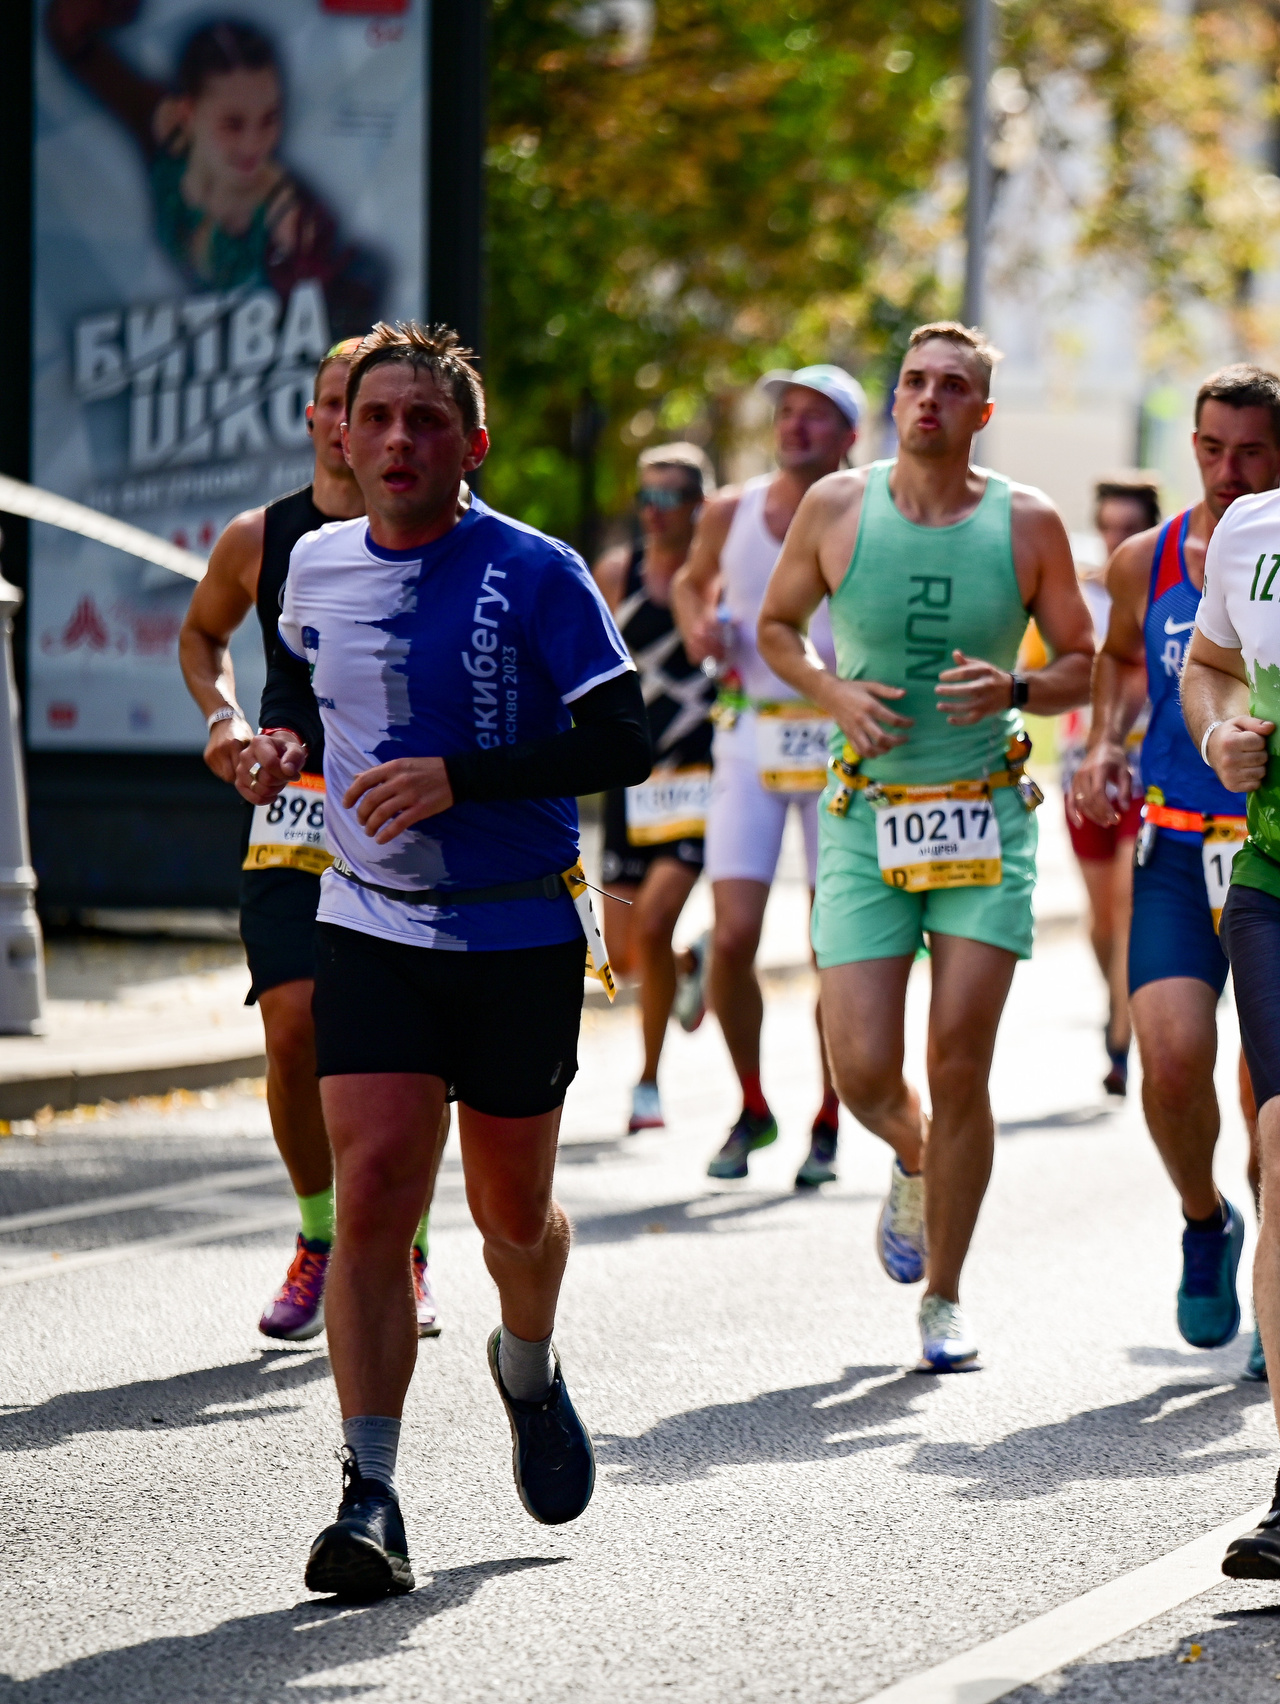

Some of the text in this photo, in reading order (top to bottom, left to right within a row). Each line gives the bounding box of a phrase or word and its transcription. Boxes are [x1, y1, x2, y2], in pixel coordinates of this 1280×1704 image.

[74, 279, 331, 393] БИТВА
[905, 575, 952, 681] RUN
[461, 562, 511, 750] екибегут
[502, 645, 518, 684] 2023
[266, 795, 325, 829] 898
[884, 808, 990, 847] 10217
[892, 869, 907, 889] D
